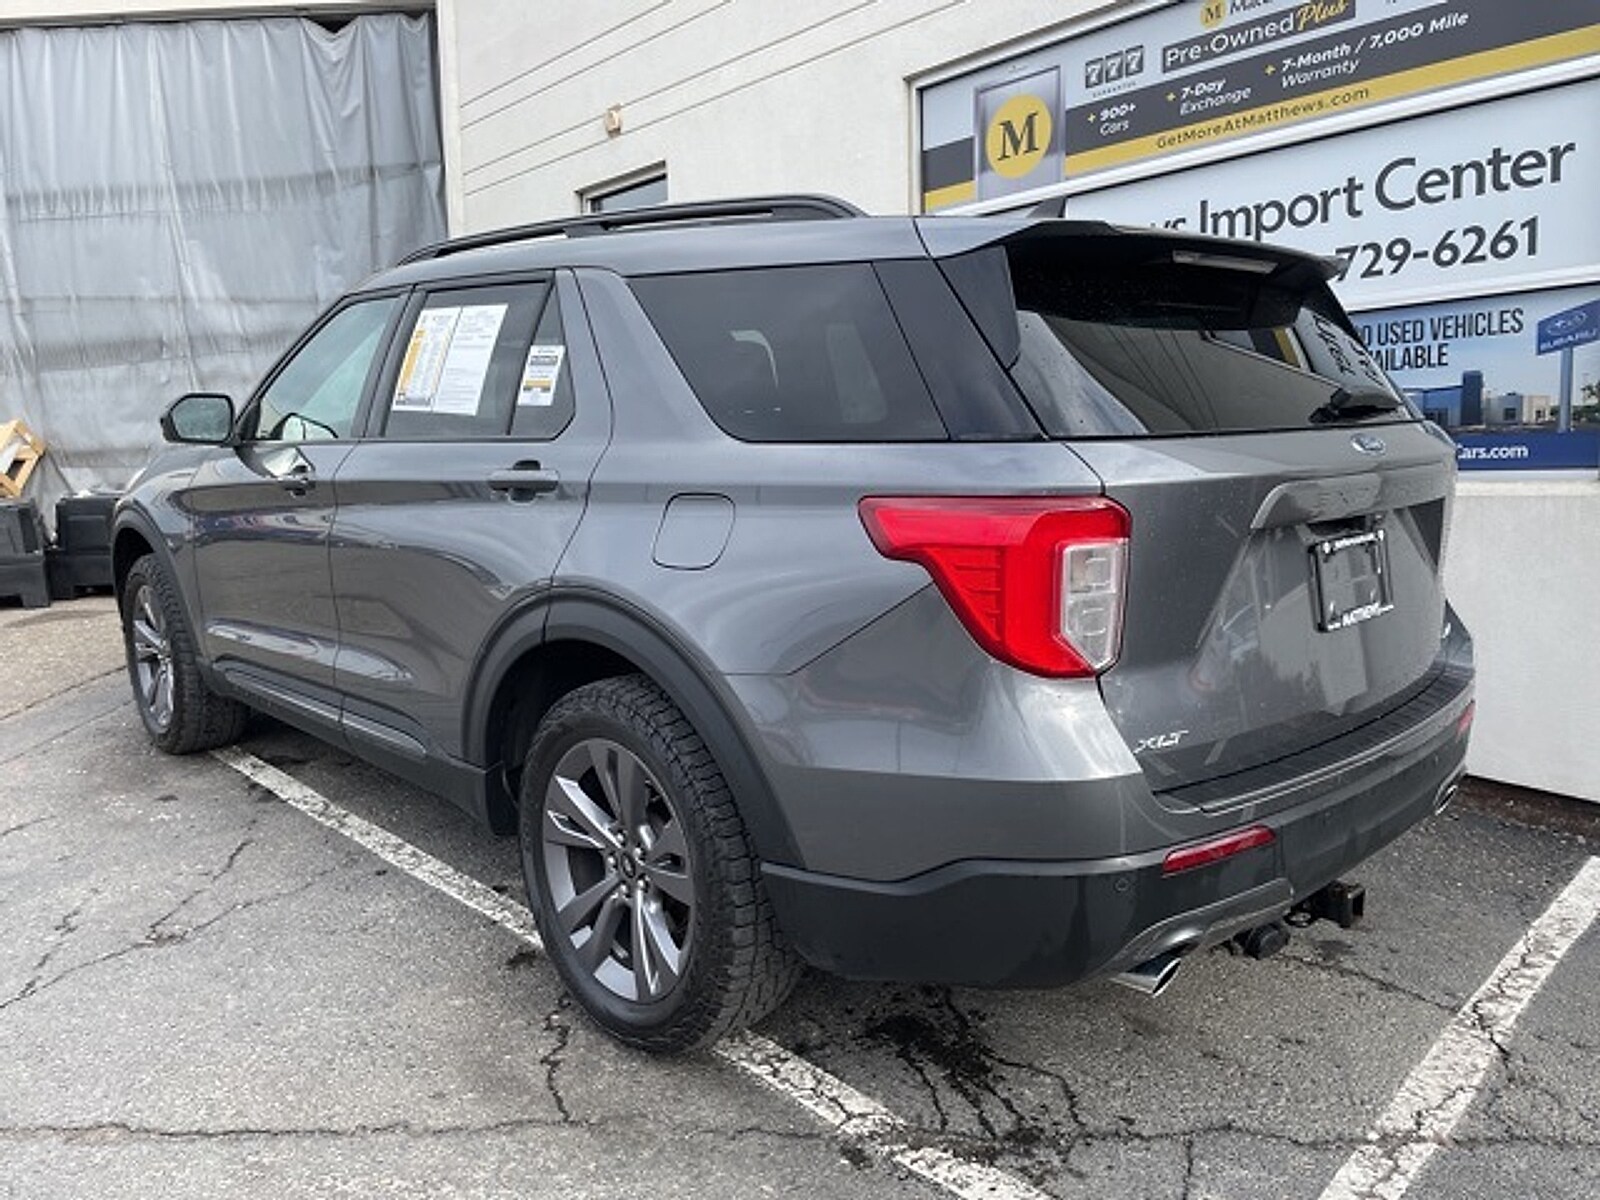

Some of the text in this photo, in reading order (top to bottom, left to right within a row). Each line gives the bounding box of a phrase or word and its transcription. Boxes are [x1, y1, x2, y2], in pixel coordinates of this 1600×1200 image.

[1281, 42, 1351, 72] 7-Month
[1428, 11, 1469, 34] Mile
[1180, 77, 1226, 100] 7-Day
[1281, 58, 1360, 88] Warranty
[1155, 87, 1370, 150] GetMoreAtMatthews.com
[1180, 86, 1252, 116] Exchange
[997, 110, 1040, 161] M
[1100, 119, 1130, 136] Cars
[1200, 142, 1576, 242] Import Center
[1377, 319, 1424, 347] USED
[1429, 307, 1524, 341] VEHICLES
